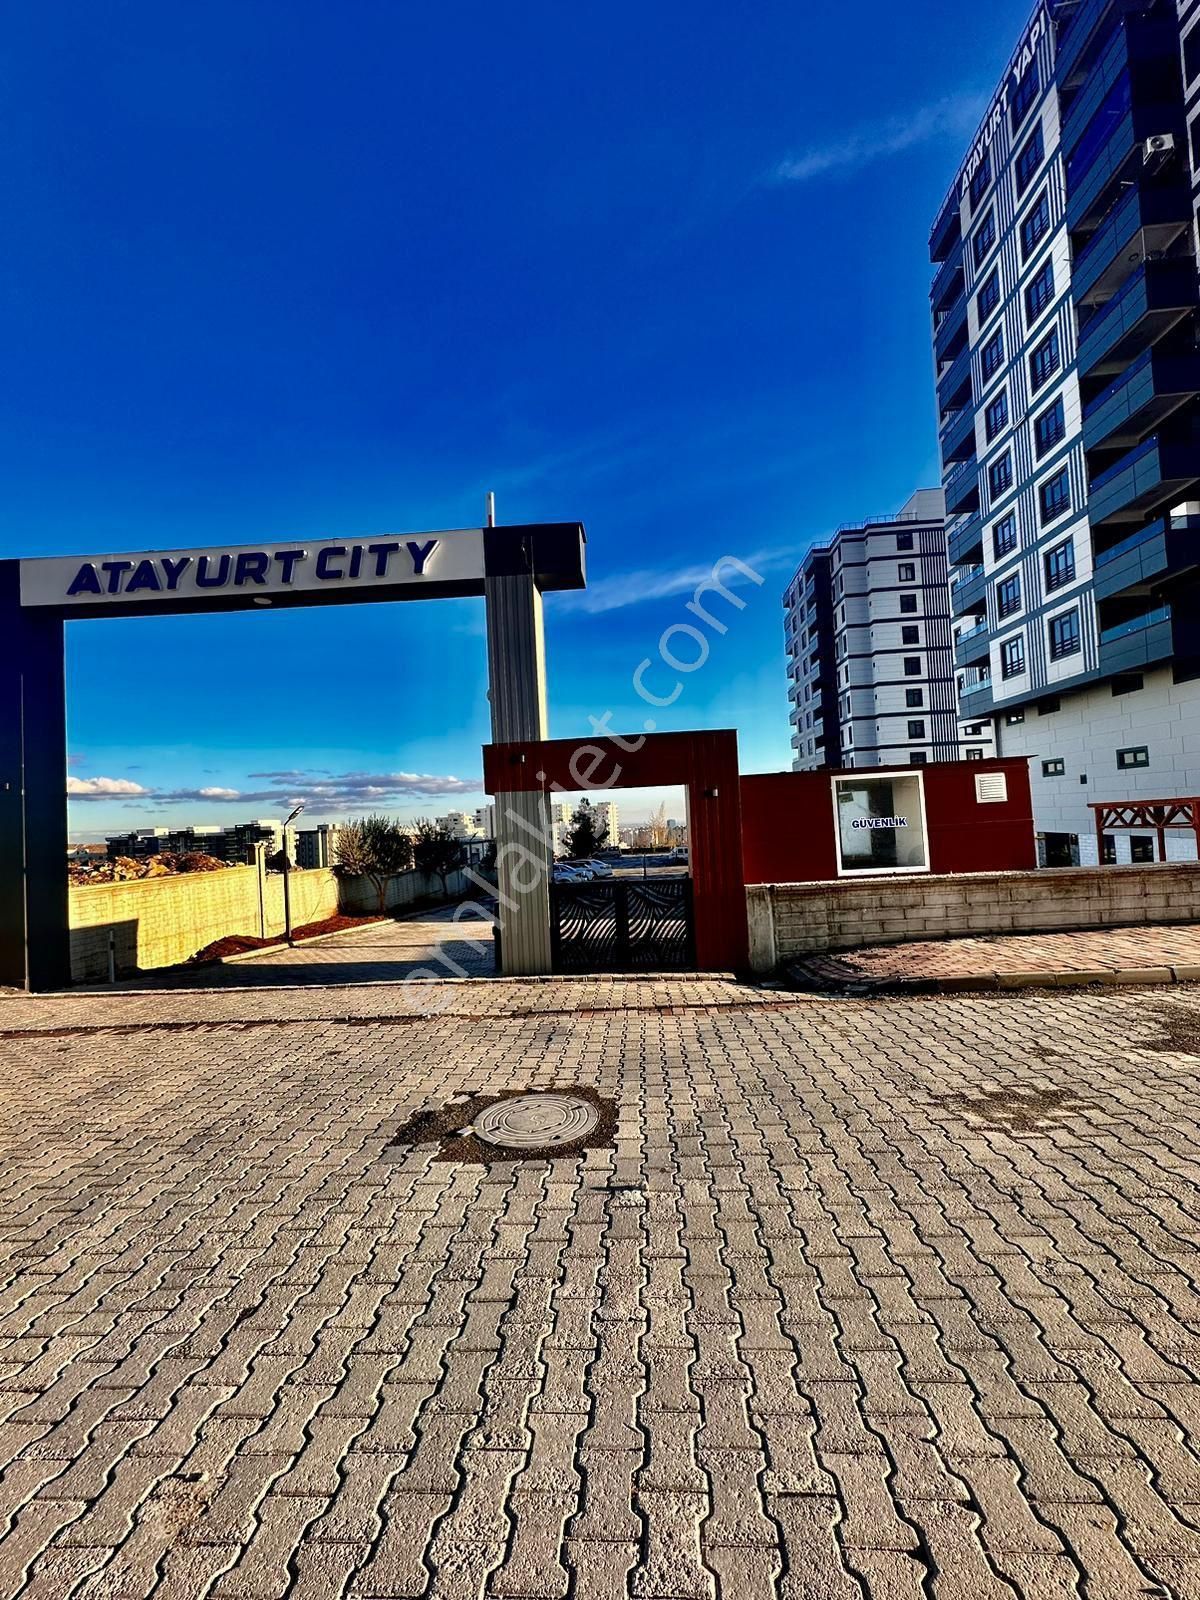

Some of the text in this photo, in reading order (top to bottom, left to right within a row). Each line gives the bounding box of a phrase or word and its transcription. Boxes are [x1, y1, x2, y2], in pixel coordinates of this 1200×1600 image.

[961, 9, 1046, 196] ATAYURT YAPI
[66, 540, 440, 596] ATAYURT CITY
[852, 815, 907, 829] GÜVENLİK
